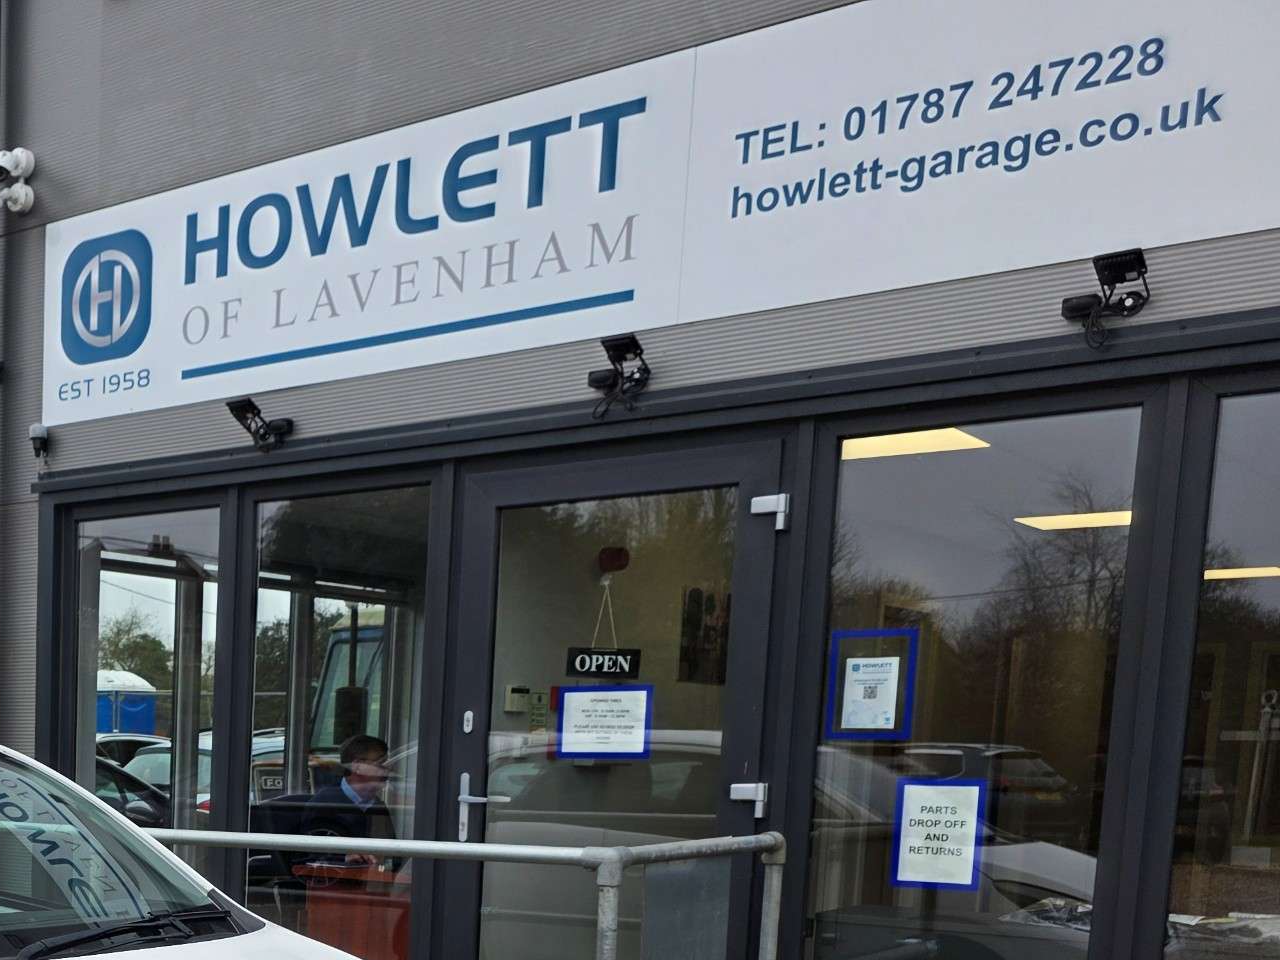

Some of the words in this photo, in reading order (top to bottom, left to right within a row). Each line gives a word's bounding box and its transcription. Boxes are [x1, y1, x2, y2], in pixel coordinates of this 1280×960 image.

[734, 121, 826, 165] TEL:
[843, 80, 974, 141] 01787
[988, 37, 1165, 110] 247228
[730, 86, 1225, 218] howlett-garage.co.uk
[184, 96, 647, 285] HOWLETT
[183, 297, 243, 346] OF
[272, 213, 640, 329] LAVENHAM
[58, 378, 94, 401] EST
[102, 368, 151, 395] 1958
[575, 654, 631, 673] OPEN
[920, 805, 958, 815] PARTS
[908, 818, 941, 828] DROP
[944, 819, 967, 829] OFF
[908, 845, 963, 856] RETURNS
[924, 833, 949, 842] AND
